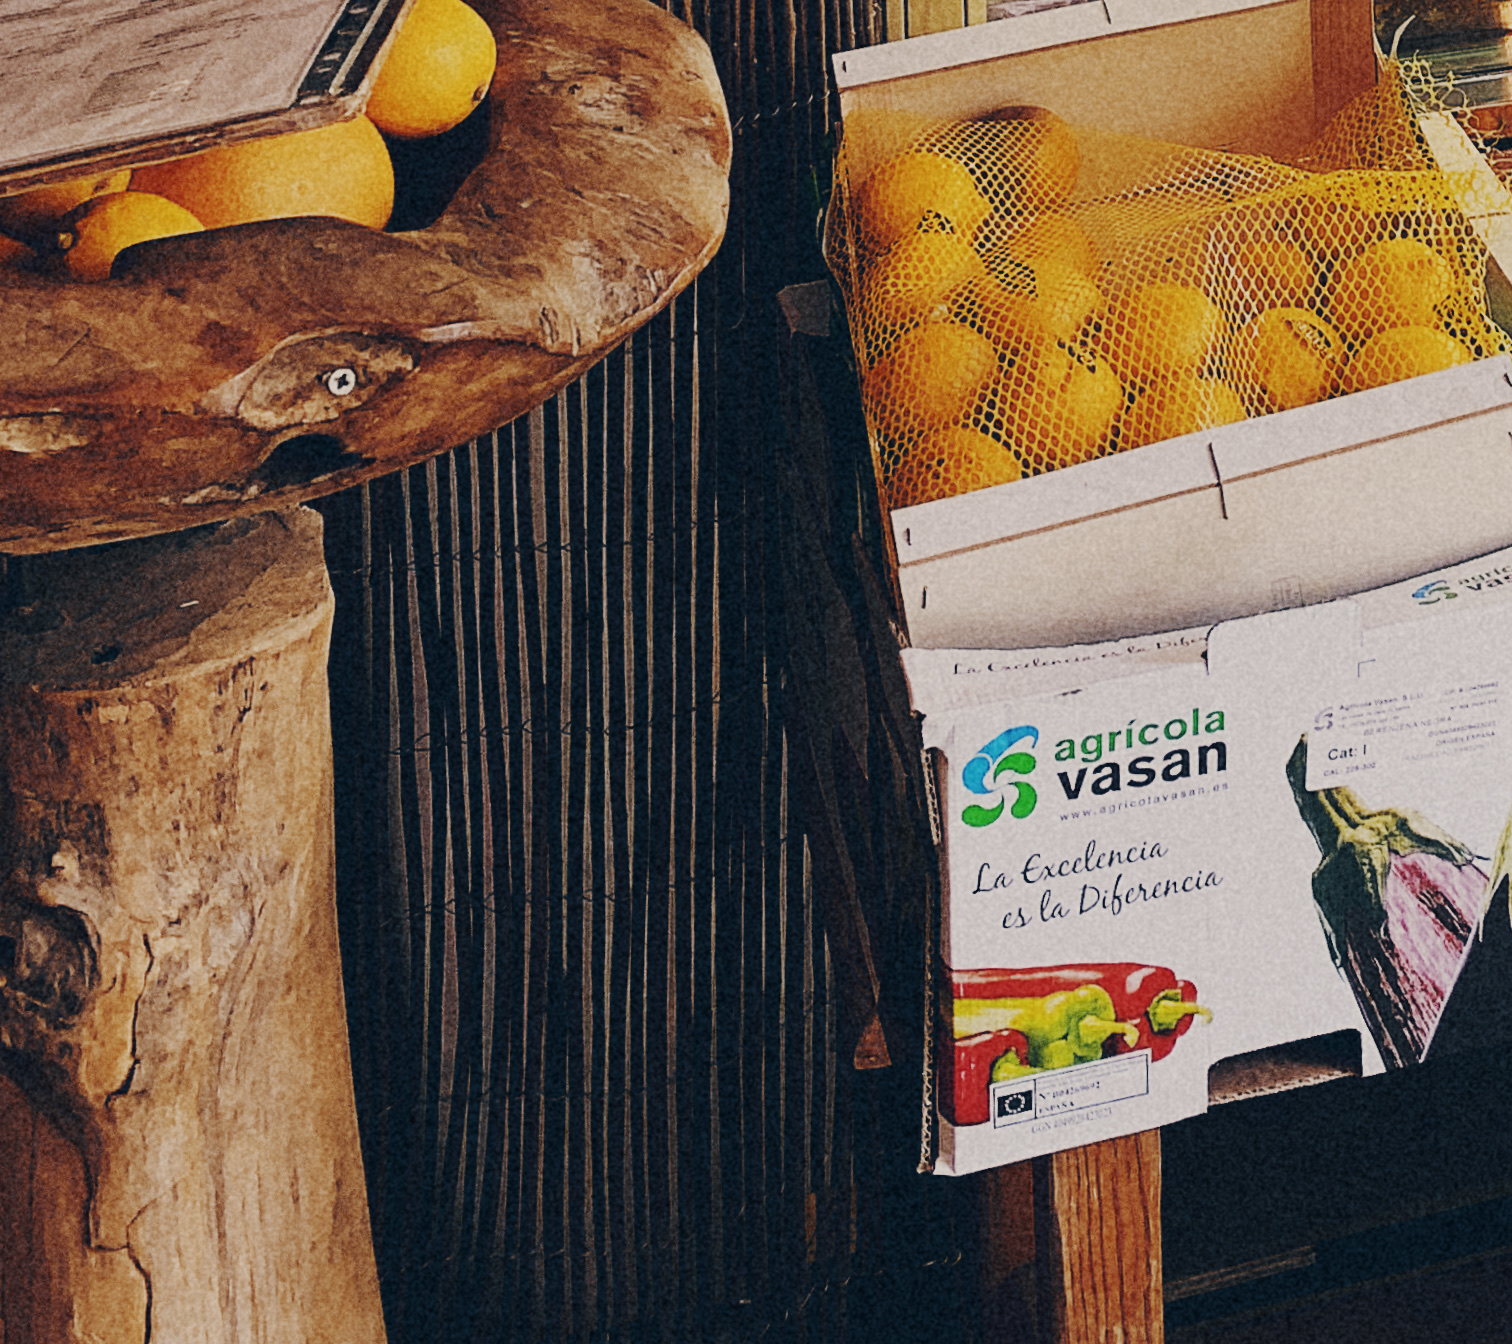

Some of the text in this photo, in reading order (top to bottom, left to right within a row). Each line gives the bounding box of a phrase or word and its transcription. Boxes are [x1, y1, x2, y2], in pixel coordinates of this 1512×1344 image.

[1054, 708, 1226, 763] agrícola
[1328, 746, 1358, 761] Cat:
[1057, 741, 1227, 801] vasan
[1059, 782, 1229, 822] www.agricolavasan.es
[972, 839, 1169, 895] La Excelencia
[1002, 870, 1224, 929] es la Diferencia
